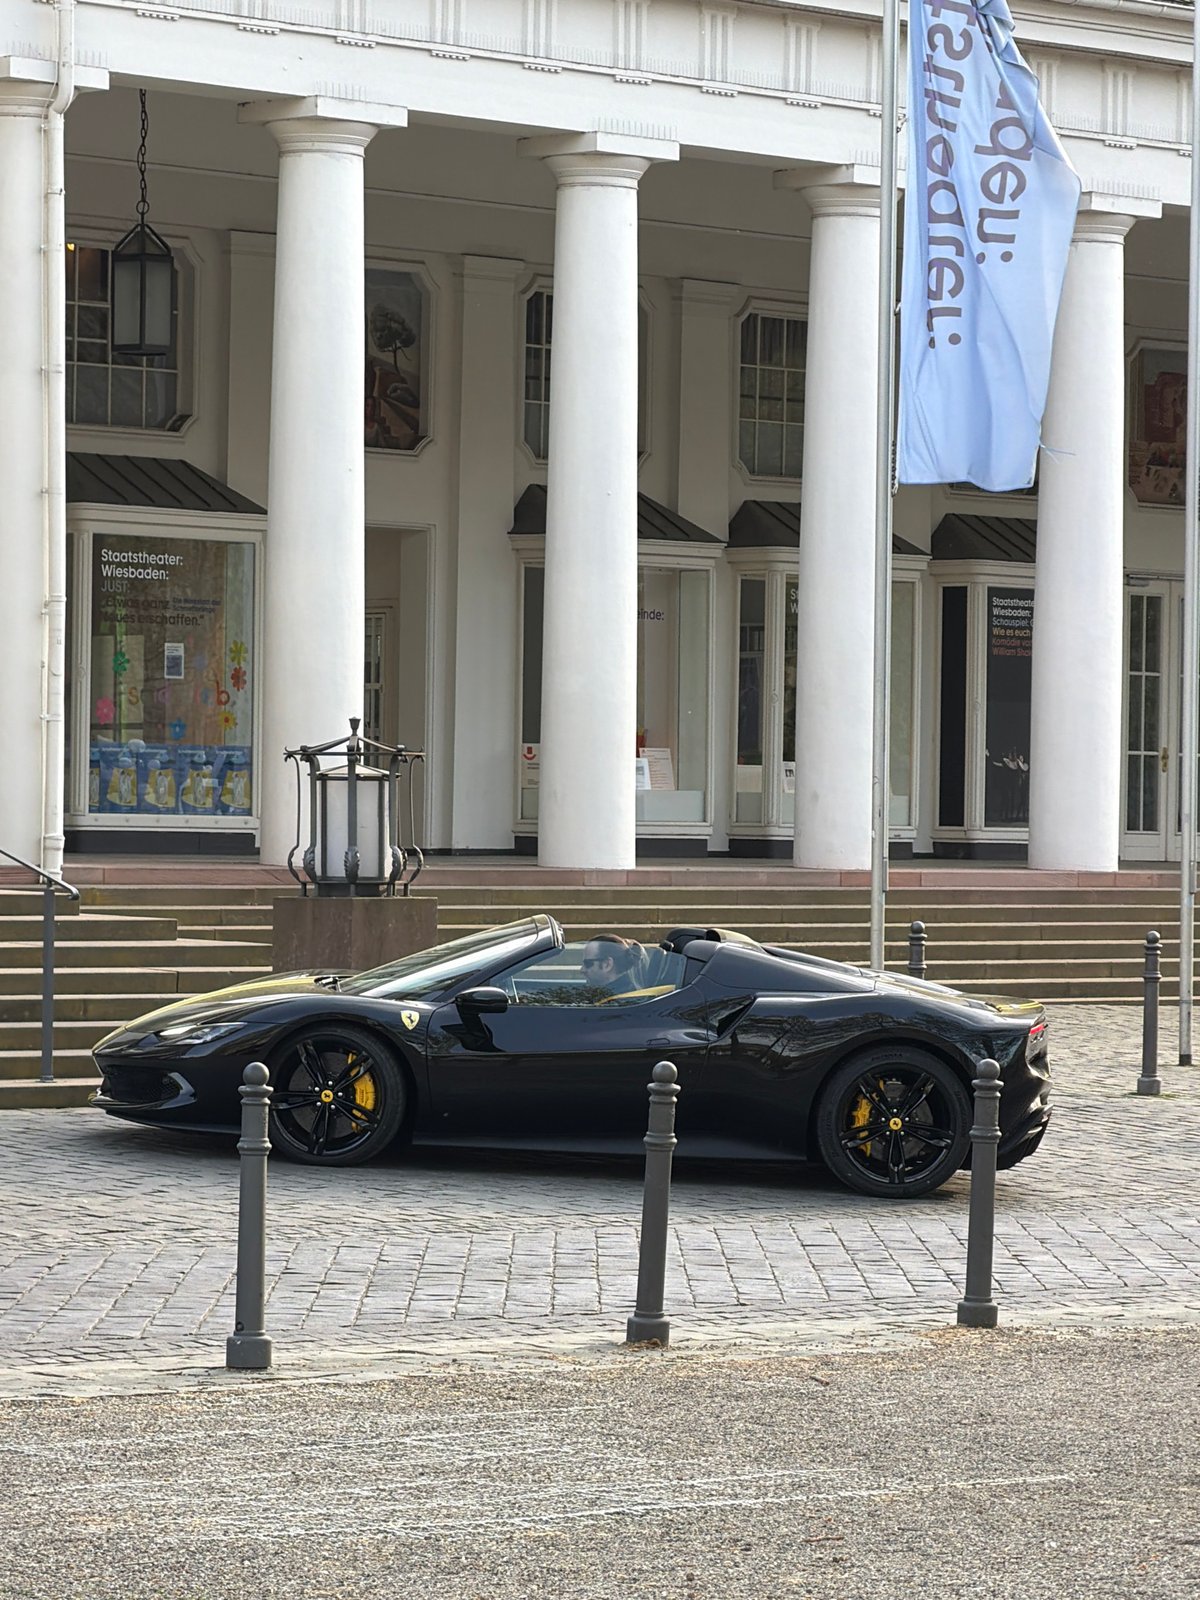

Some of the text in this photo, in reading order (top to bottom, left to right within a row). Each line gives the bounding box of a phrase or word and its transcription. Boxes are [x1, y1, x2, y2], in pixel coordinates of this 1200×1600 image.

[101, 548, 183, 566] Staatstheater:
[101, 564, 169, 580] Wiesbaden:
[101, 580, 130, 593] JUST:
[992, 597, 1034, 608] Staatstheate
[992, 607, 1032, 617] Wiesbaden:
